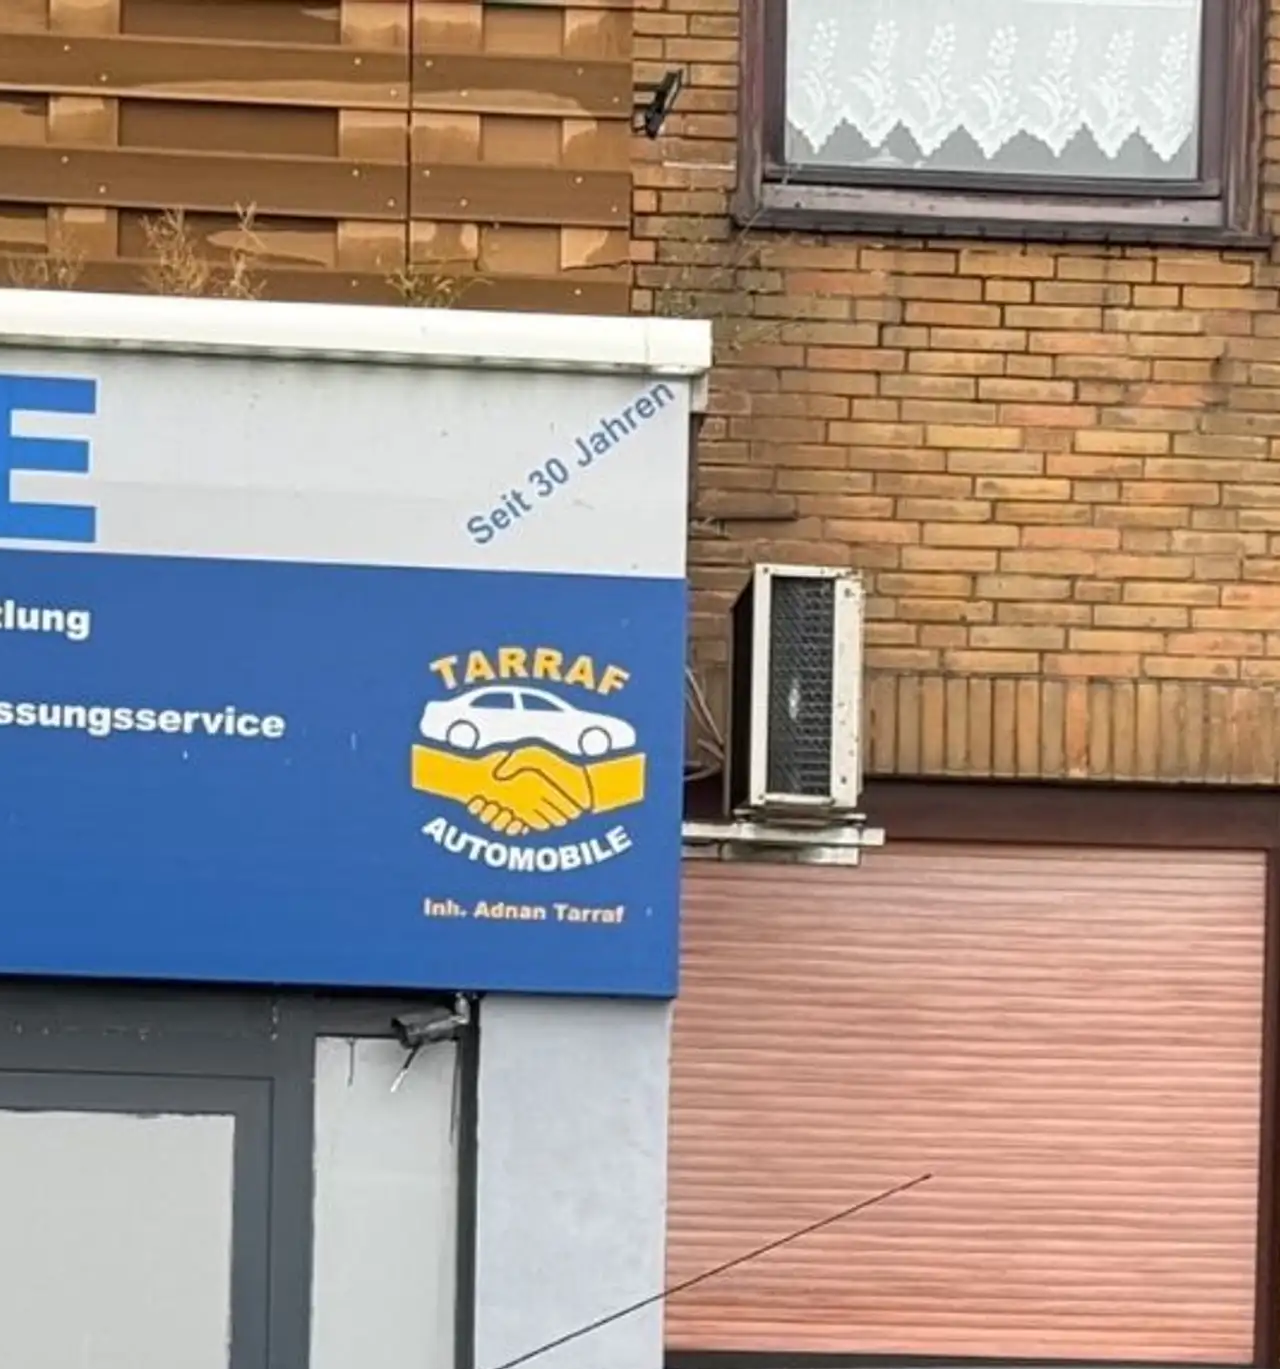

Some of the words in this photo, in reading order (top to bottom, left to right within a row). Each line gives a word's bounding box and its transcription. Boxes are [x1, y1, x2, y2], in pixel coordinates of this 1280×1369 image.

[466, 489, 533, 545] Seit
[527, 458, 570, 498] 30
[575, 381, 676, 469] Jahren
[429, 647, 631, 696] TARRAF
[422, 816, 633, 872] AUTOMOBILE
[424, 898, 467, 918] Inh.
[473, 900, 547, 922] Adnan
[553, 903, 625, 924] Tarraf
